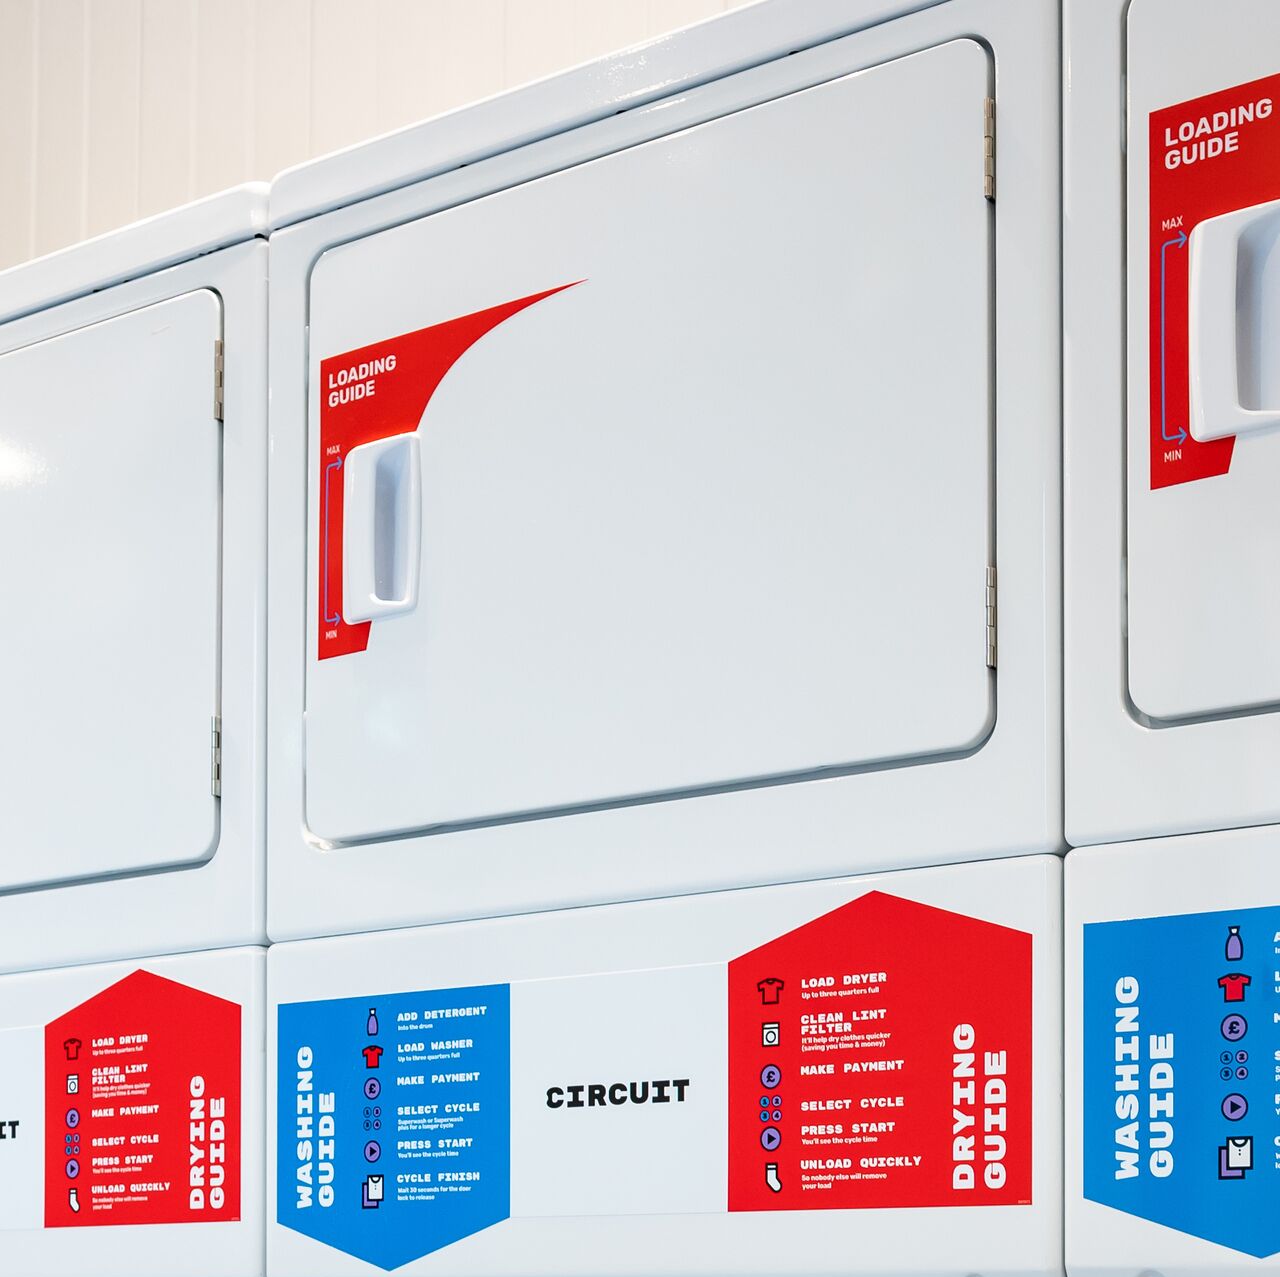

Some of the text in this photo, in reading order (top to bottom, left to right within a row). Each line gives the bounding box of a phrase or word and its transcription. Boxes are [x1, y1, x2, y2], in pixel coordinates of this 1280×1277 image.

[1164, 98, 1272, 147] LOADING
[1165, 128, 1238, 169] GUIDE
[1162, 216, 1183, 231] MAX
[328, 354, 396, 389] LOADING
[329, 380, 375, 407] GUIDE
[327, 445, 340, 455] MAX
[1164, 449, 1181, 462] MIN
[326, 630, 337, 639] MIN
[802, 972, 886, 988] LOAD DRYER
[397, 1006, 486, 1021] ADD DETERGENT
[801, 1009, 886, 1025] CLEAN LINT
[801, 1022, 852, 1035] FILTER
[92, 1034, 148, 1047] LOAD DRYER
[398, 1039, 473, 1052] LOAD WASHER
[801, 1060, 904, 1075] MAKE PAYMENT
[397, 1072, 480, 1085] MAKE PAYMENT
[1115, 977, 1139, 1180] WASHING
[547, 1079, 689, 1108] CIRCUIT
[398, 1103, 480, 1115] SELECT CYCLE
[801, 1097, 904, 1111] SELECT CYCLE
[953, 1024, 975, 1189] DRYING
[1150, 1033, 1173, 1177] GUIDE
[297, 1047, 313, 1208] WASHING
[984, 1051, 1006, 1189] GUIDE
[802, 1122, 895, 1135] PRESS START
[190, 1076, 204, 1209] DRYING
[319, 1092, 335, 1207] GUIDE
[398, 1138, 472, 1150] PRESS START
[210, 1097, 225, 1209] GUIDE
[801, 1156, 921, 1169] UNLOAD QUICKLY
[397, 1172, 480, 1183] CYCLE FINISH
